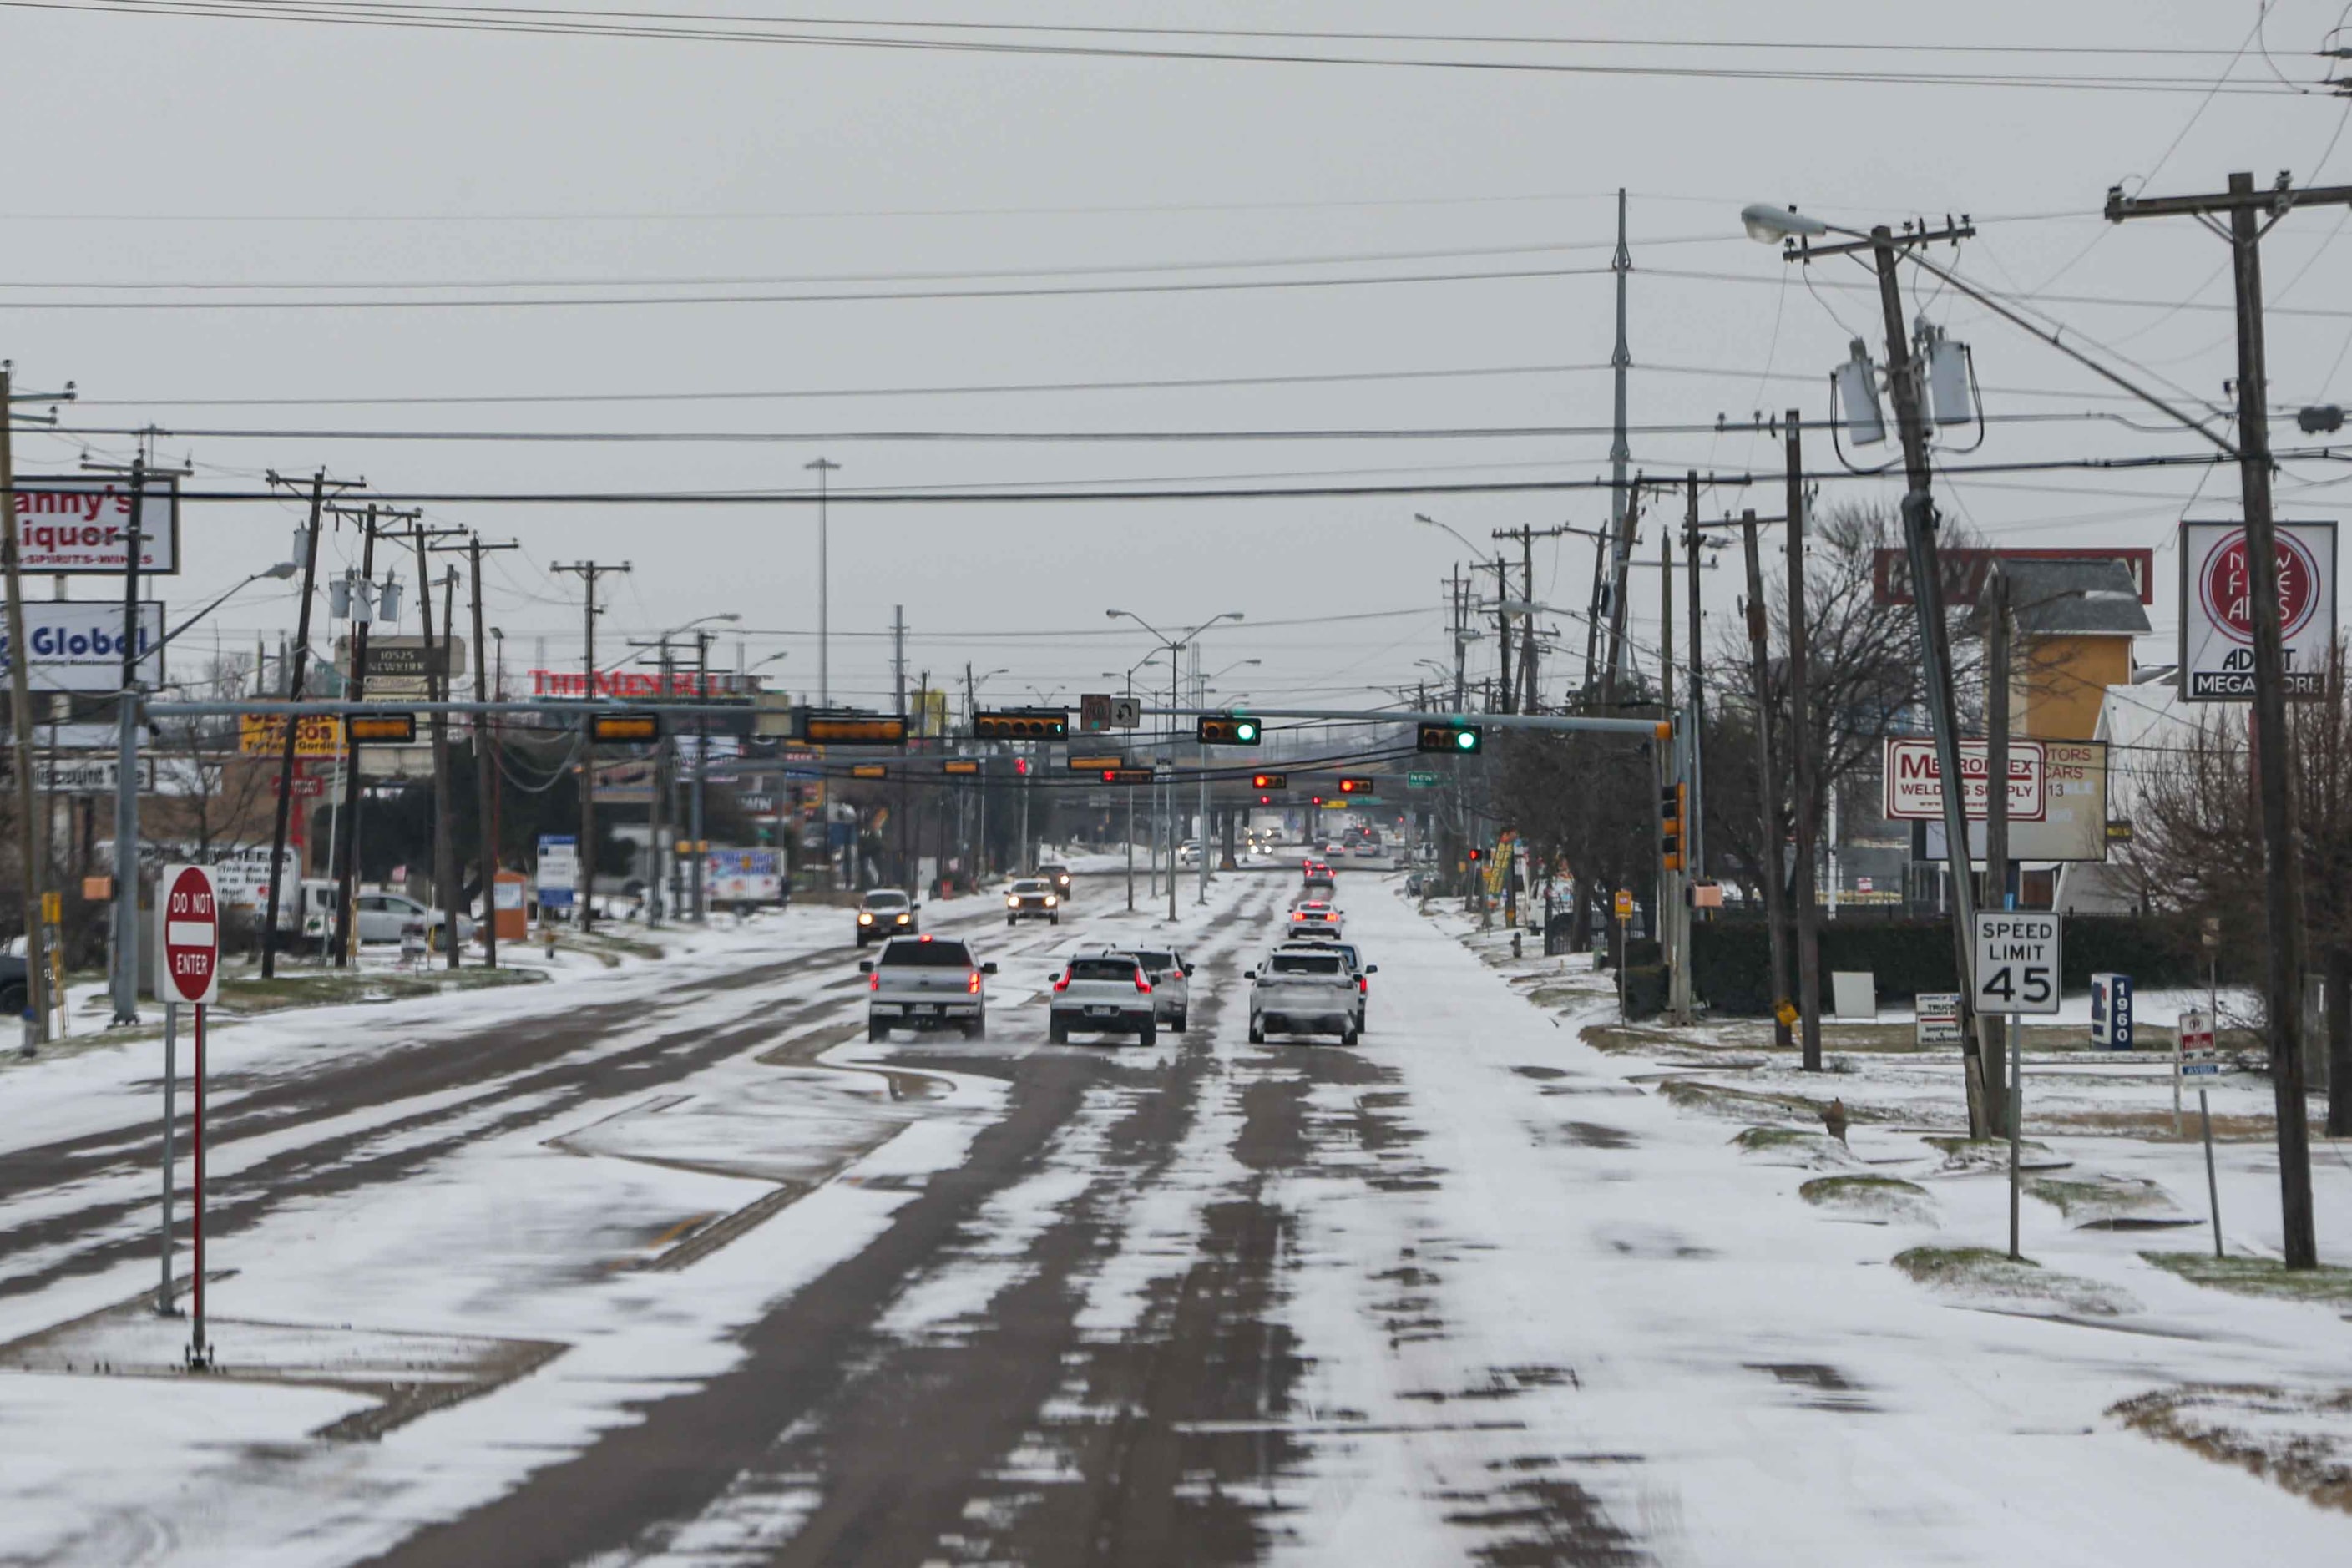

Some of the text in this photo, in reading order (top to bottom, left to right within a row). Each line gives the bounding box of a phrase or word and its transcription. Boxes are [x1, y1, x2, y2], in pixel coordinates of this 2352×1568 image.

[14, 485, 132, 521] anny's
[19, 520, 119, 553] iquor
[2230, 552, 2291, 569] NW
[2228, 596, 2290, 620] AS
[2222, 648, 2296, 671] ADT
[173, 893, 211, 914] DO NOT
[1983, 923, 2052, 939] SPEED
[1990, 944, 2045, 960] LIMIT
[176, 953, 208, 975] ENTER
[1982, 967, 2051, 1004] 45
[2116, 982, 2128, 1042] 1960
